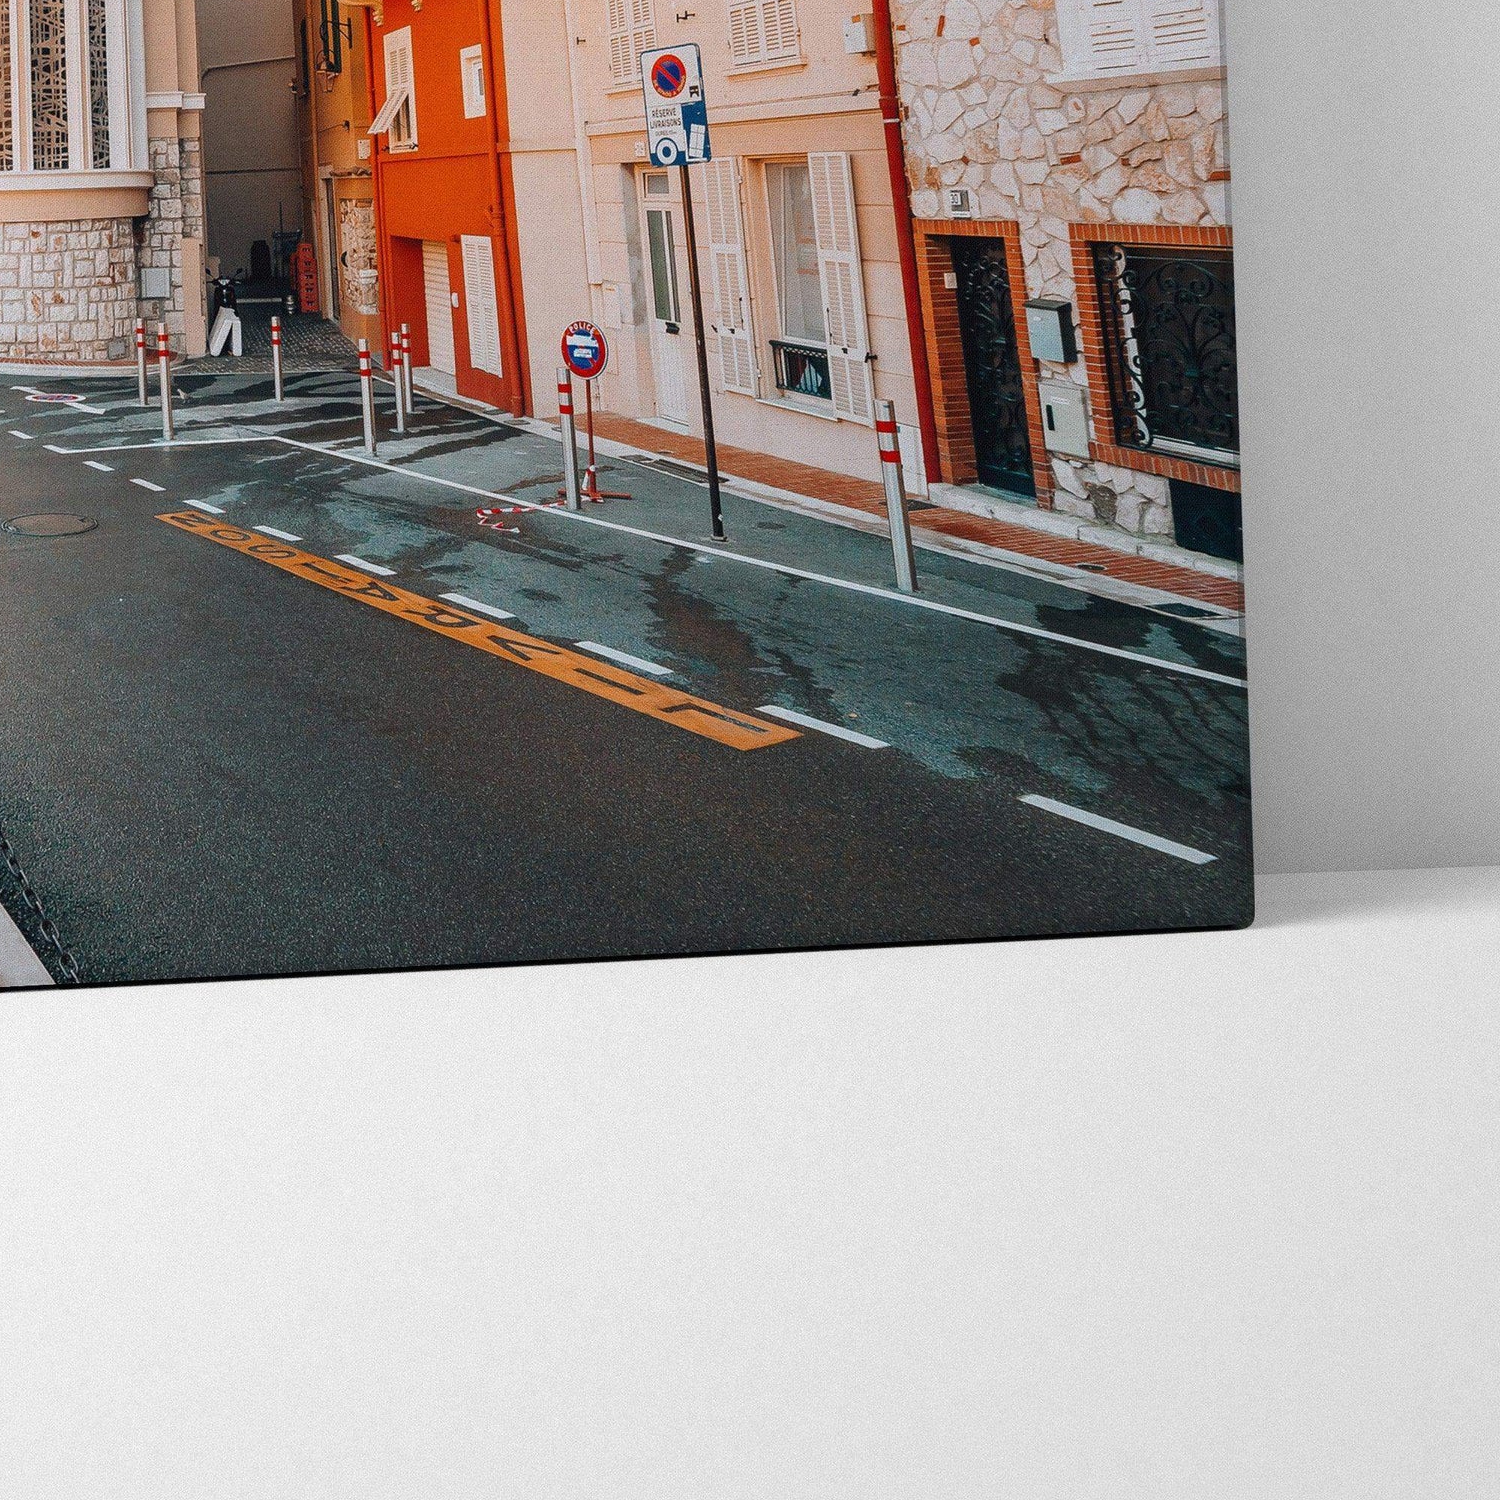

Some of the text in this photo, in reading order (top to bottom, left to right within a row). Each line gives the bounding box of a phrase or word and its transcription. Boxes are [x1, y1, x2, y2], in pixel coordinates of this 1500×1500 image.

[650, 117, 682, 129] LIVRAISONS
[568, 321, 596, 337] POLICE
[170, 513, 769, 733] LIVRAISON
